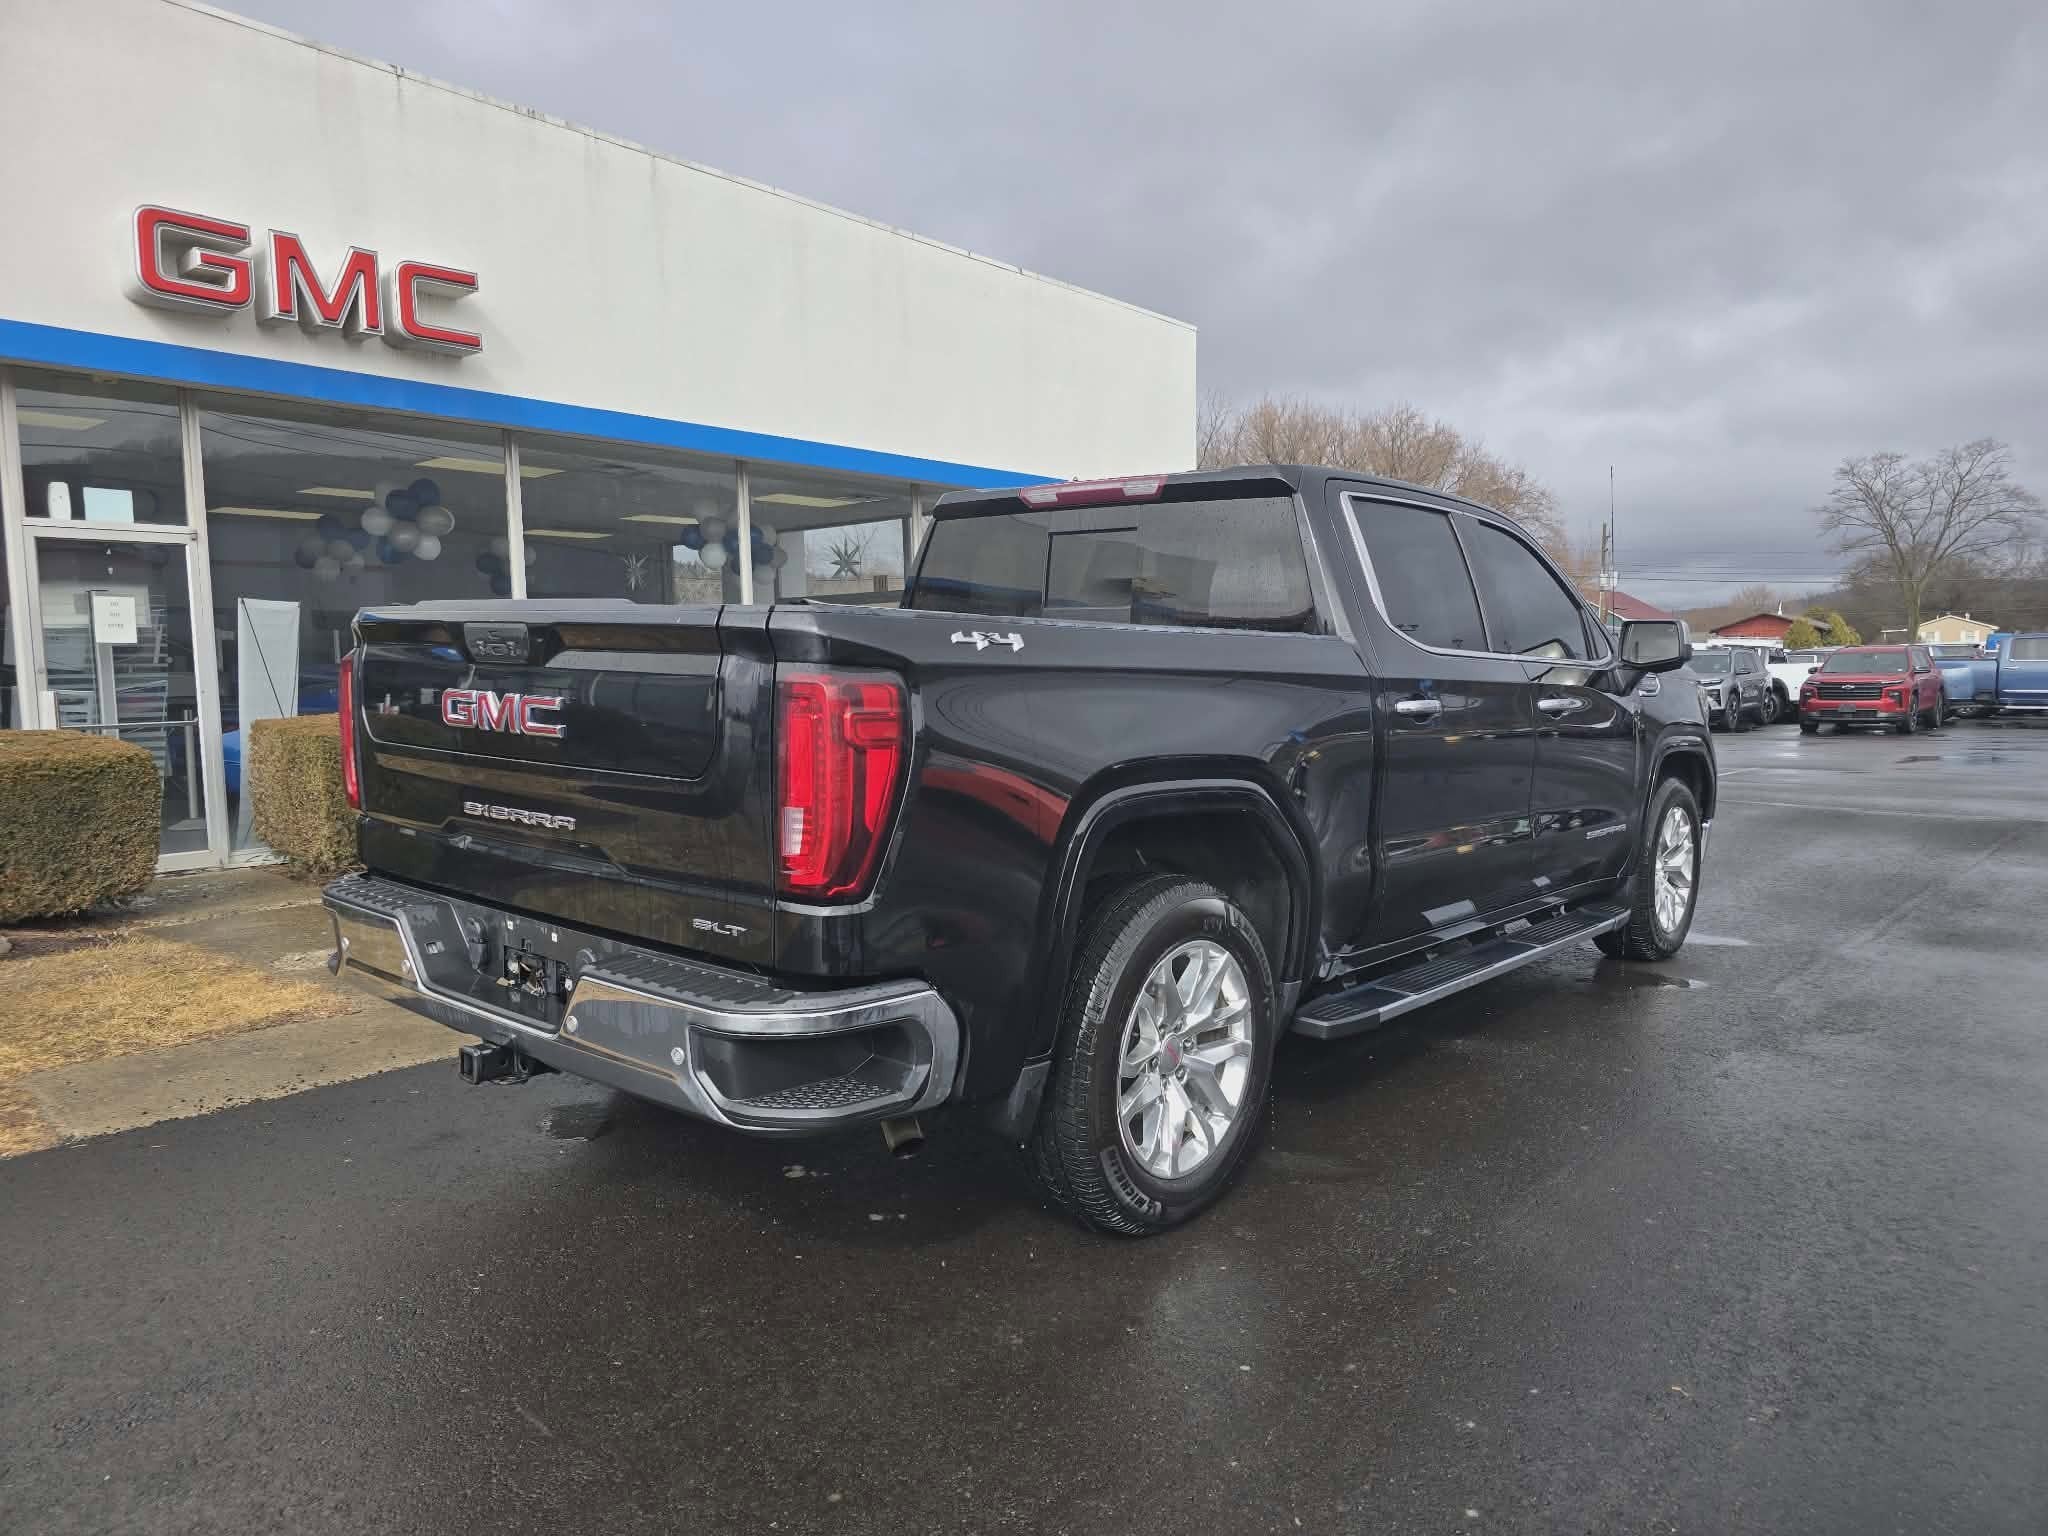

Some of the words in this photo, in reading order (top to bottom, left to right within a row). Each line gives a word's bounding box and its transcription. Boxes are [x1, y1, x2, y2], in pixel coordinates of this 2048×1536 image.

[133, 204, 483, 353] GMC
[442, 688, 567, 739] GMC
[463, 801, 577, 831] SIERRA
[692, 918, 748, 937] SLT
